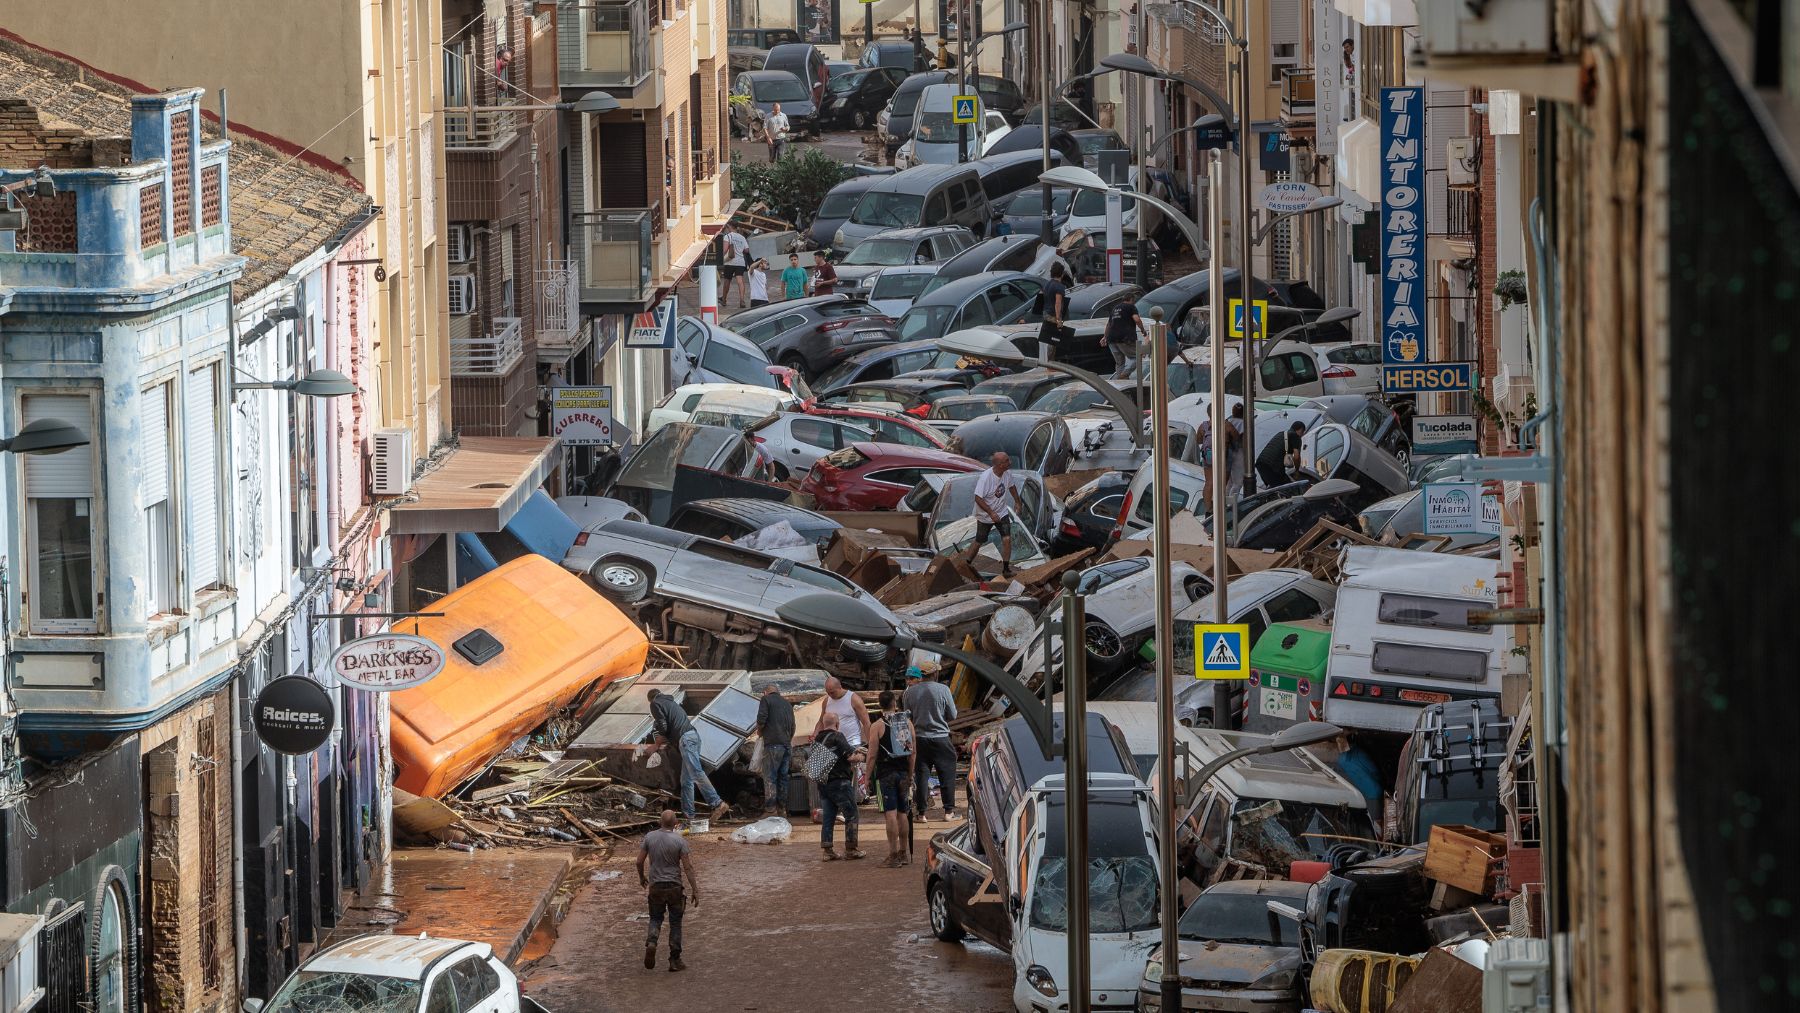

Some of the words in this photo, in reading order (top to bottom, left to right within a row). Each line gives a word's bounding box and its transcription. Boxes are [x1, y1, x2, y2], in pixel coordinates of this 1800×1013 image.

[1276, 184, 1306, 192] FORN
[1268, 201, 1311, 211] PASTISSERI
[1386, 90, 1420, 327] TINTORERIA
[633, 328, 661, 336] FIATC
[1386, 368, 1468, 389] HERSOL
[555, 413, 610, 435] GUERRERO
[1417, 421, 1472, 433] Tucolada
[1482, 502, 1500, 521] INM
[376, 640, 396, 650] PUB
[342, 647, 433, 671] DARKNESS
[358, 671, 392, 682] METAL
[395, 668, 417, 680] BAR
[262, 706, 320, 723] Raices
